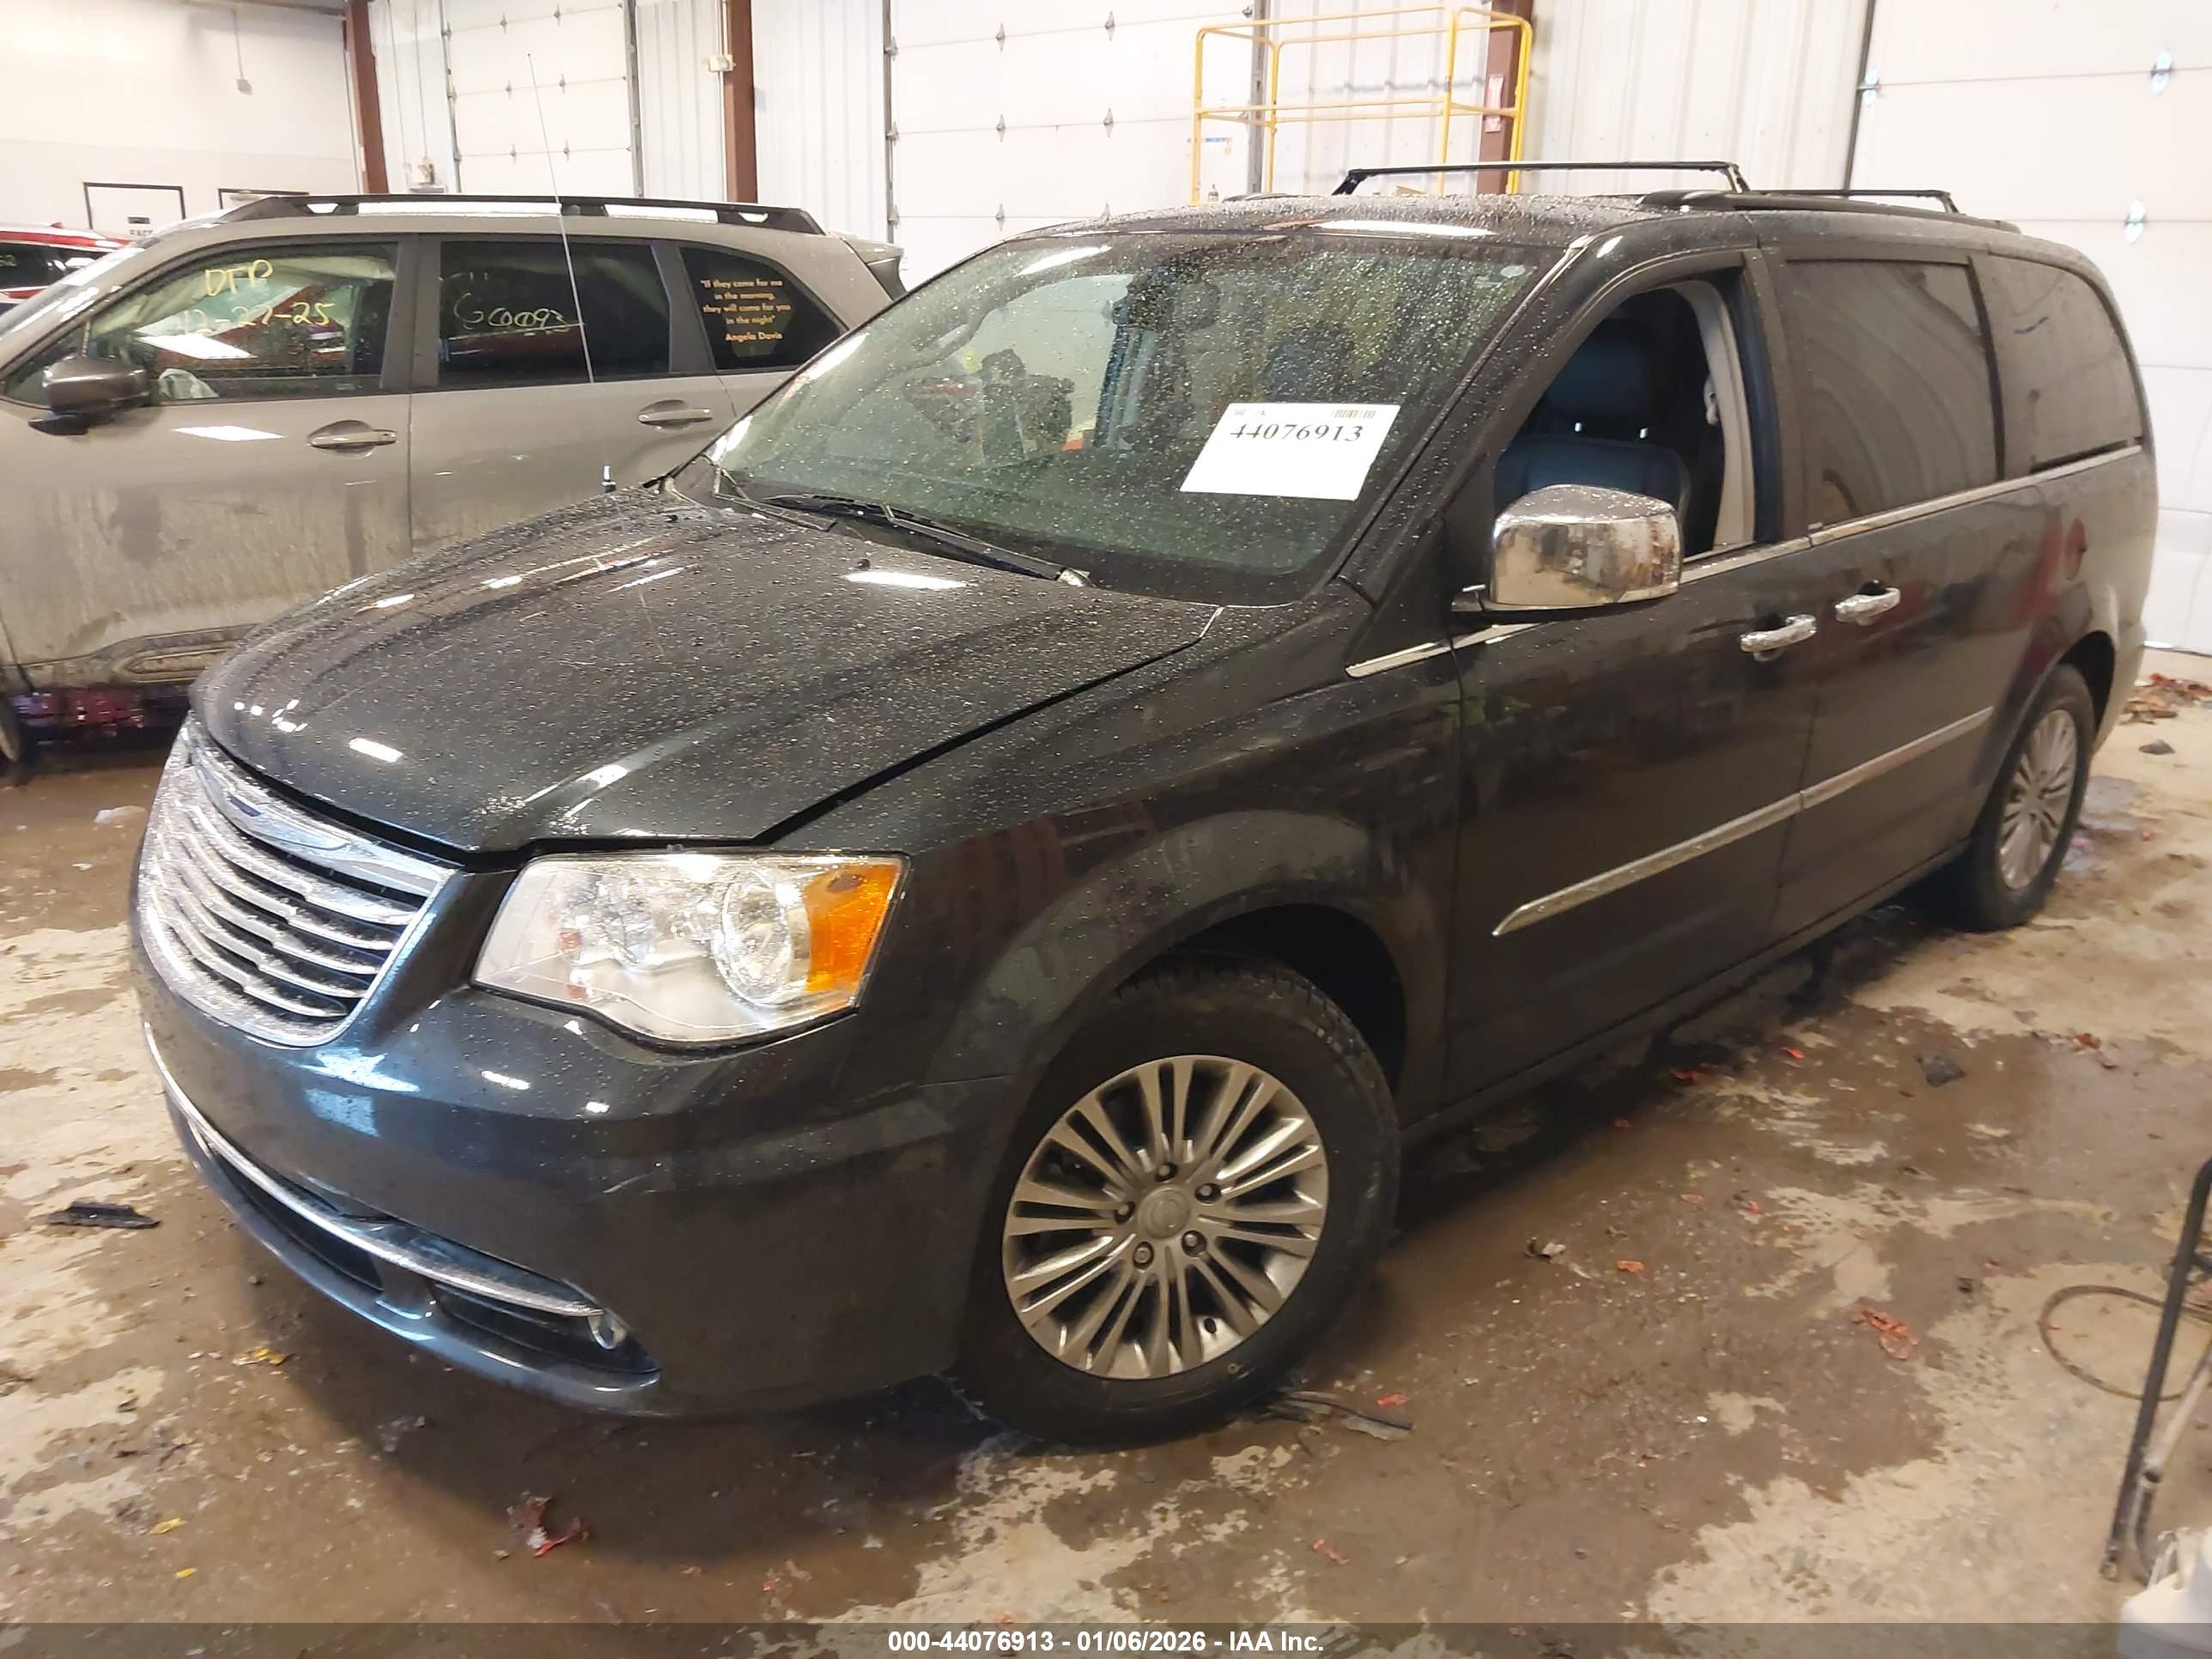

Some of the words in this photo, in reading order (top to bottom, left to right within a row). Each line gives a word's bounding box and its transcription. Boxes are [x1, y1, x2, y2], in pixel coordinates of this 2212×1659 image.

[726, 332, 757, 343] Angela
[757, 331, 783, 340] Davis
[1230, 423, 1364, 442] 44076913
